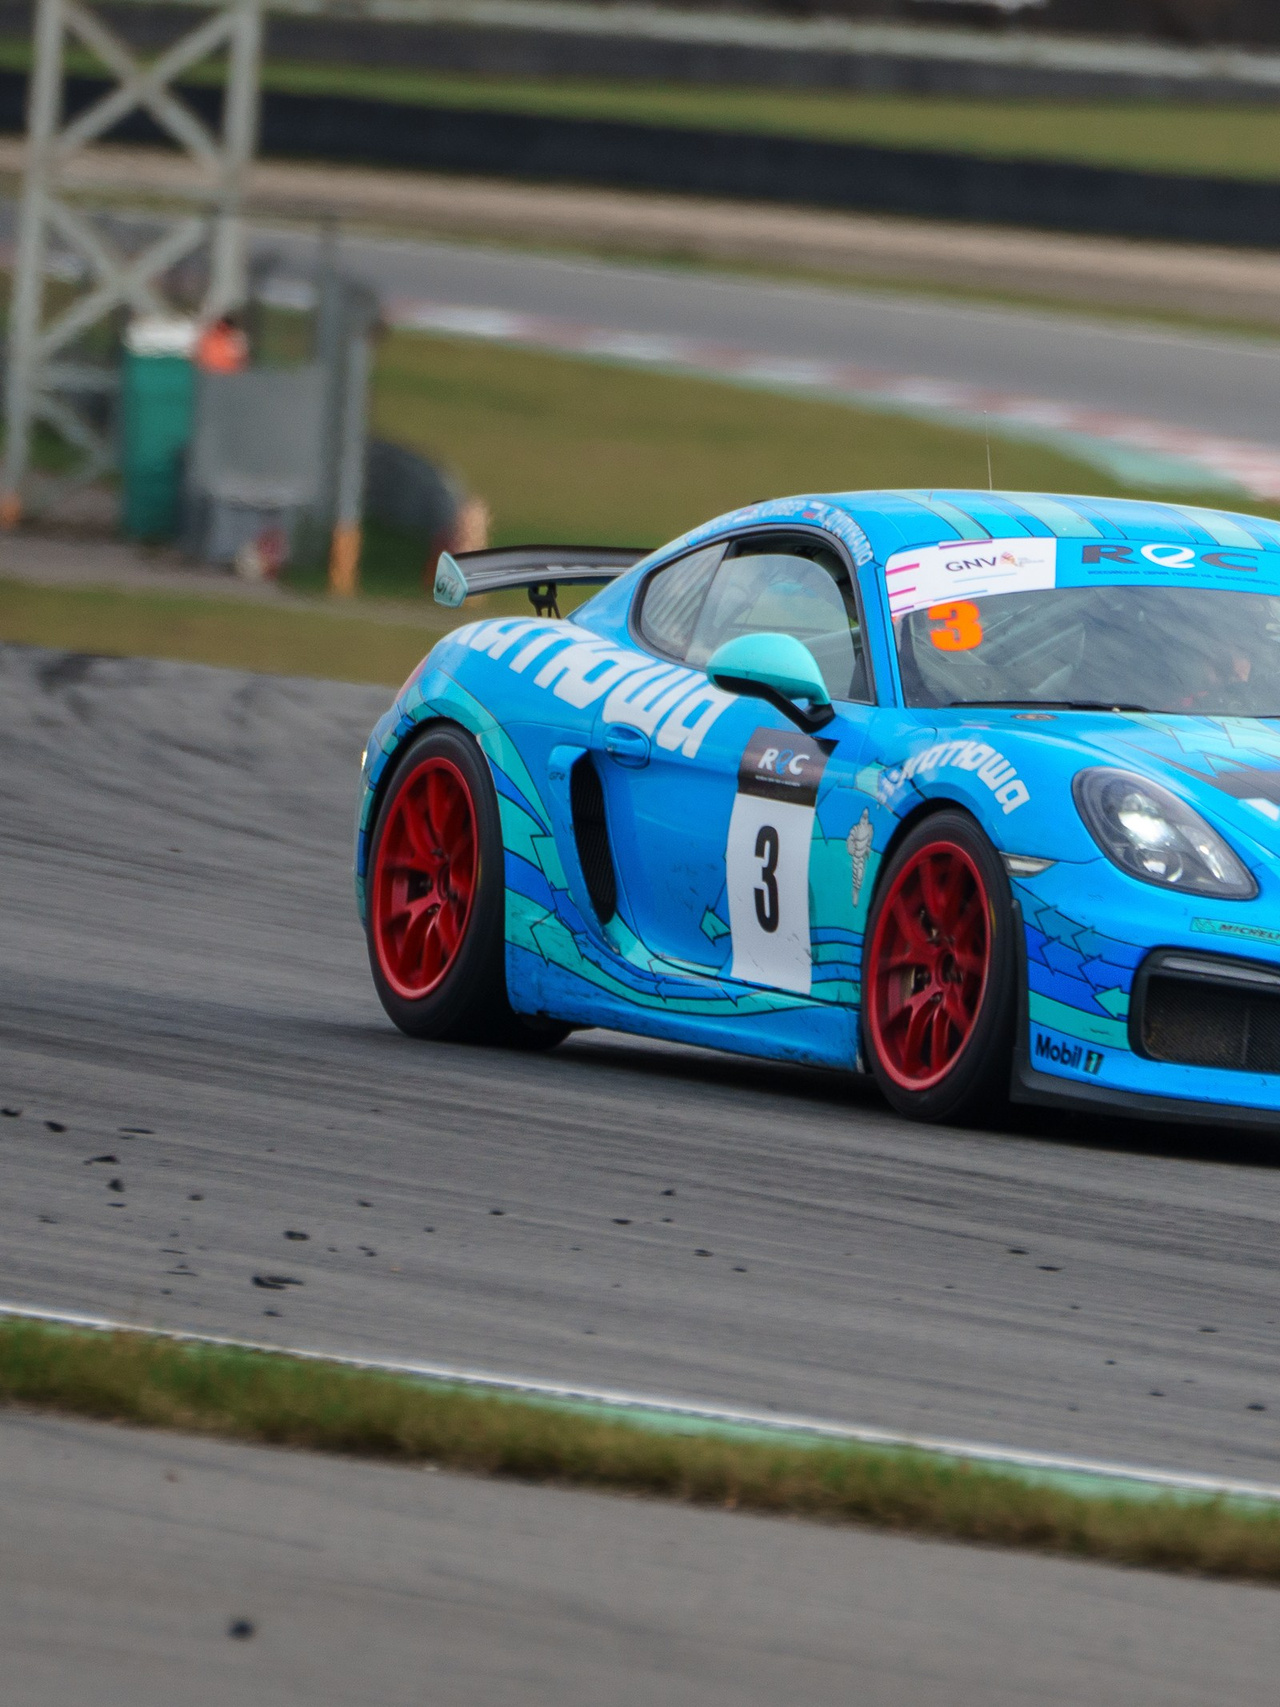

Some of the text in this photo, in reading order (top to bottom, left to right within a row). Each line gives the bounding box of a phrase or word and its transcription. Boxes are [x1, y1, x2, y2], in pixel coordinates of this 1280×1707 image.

[945, 556, 997, 572] GNV
[927, 600, 983, 652] 3
[753, 825, 780, 934] 3
[1035, 1033, 1103, 1075] Mobil 1
